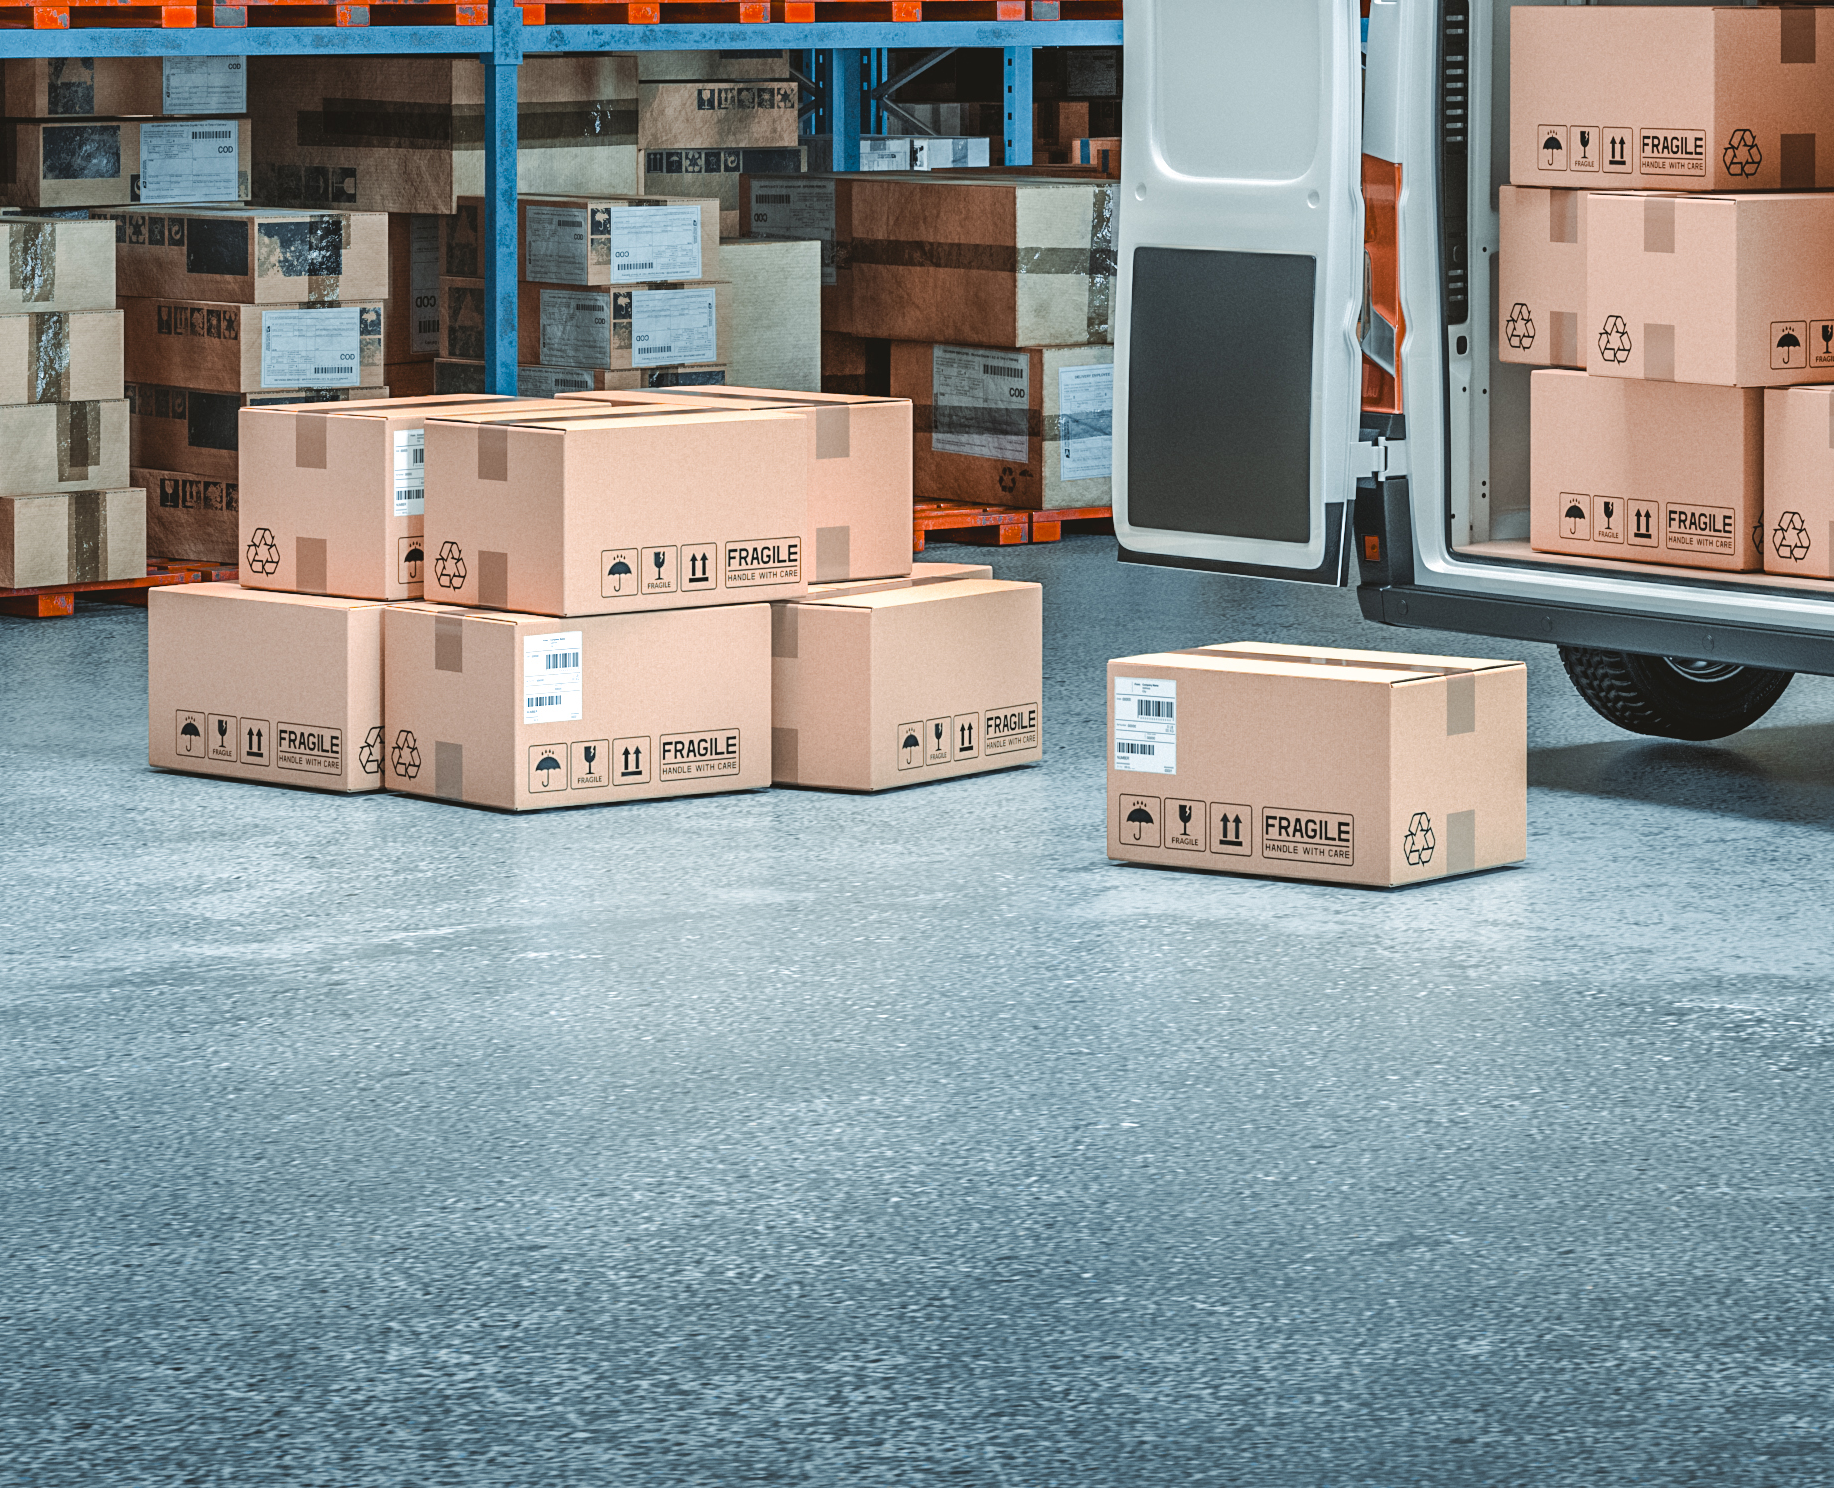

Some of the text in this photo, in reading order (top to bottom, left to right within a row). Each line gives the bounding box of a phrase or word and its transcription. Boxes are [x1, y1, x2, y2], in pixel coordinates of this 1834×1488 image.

[218, 144, 233, 153] COD
[1642, 135, 1703, 156] FRAGILE
[1575, 160, 1595, 168] FRAGILE
[1641, 160, 1704, 172] HANDLE WITH CARE
[614, 250, 630, 258] COD
[635, 333, 650, 341] COD
[1008, 387, 1025, 398] COD
[1668, 510, 1733, 536] FRAGILE
[1598, 530, 1619, 539] FRAGILE
[1668, 534, 1733, 550] HANDLE WITH CARE
[728, 544, 798, 568] FRAGILE
[728, 569, 798, 583] HANDLE WITH CARE
[647, 580, 671, 590] FRAGILE
[986, 710, 1036, 737] FRAGILE
[278, 729, 340, 754] FRAGILE
[663, 735, 737, 762] FRAGILE
[986, 734, 1035, 751] HANDLE WITH CARE
[212, 748, 233, 757] FRAGILE
[930, 751, 947, 761] FRAGILE
[279, 754, 340, 769] HANDLE WITH CARE
[663, 761, 737, 776] HANDLE WITH CARE
[577, 775, 603, 784] FRAGILE
[1265, 815, 1350, 843] FRAGILE
[1171, 836, 1199, 846] FRAGILE
[1265, 844, 1350, 860] HANDLE WITH CARE
